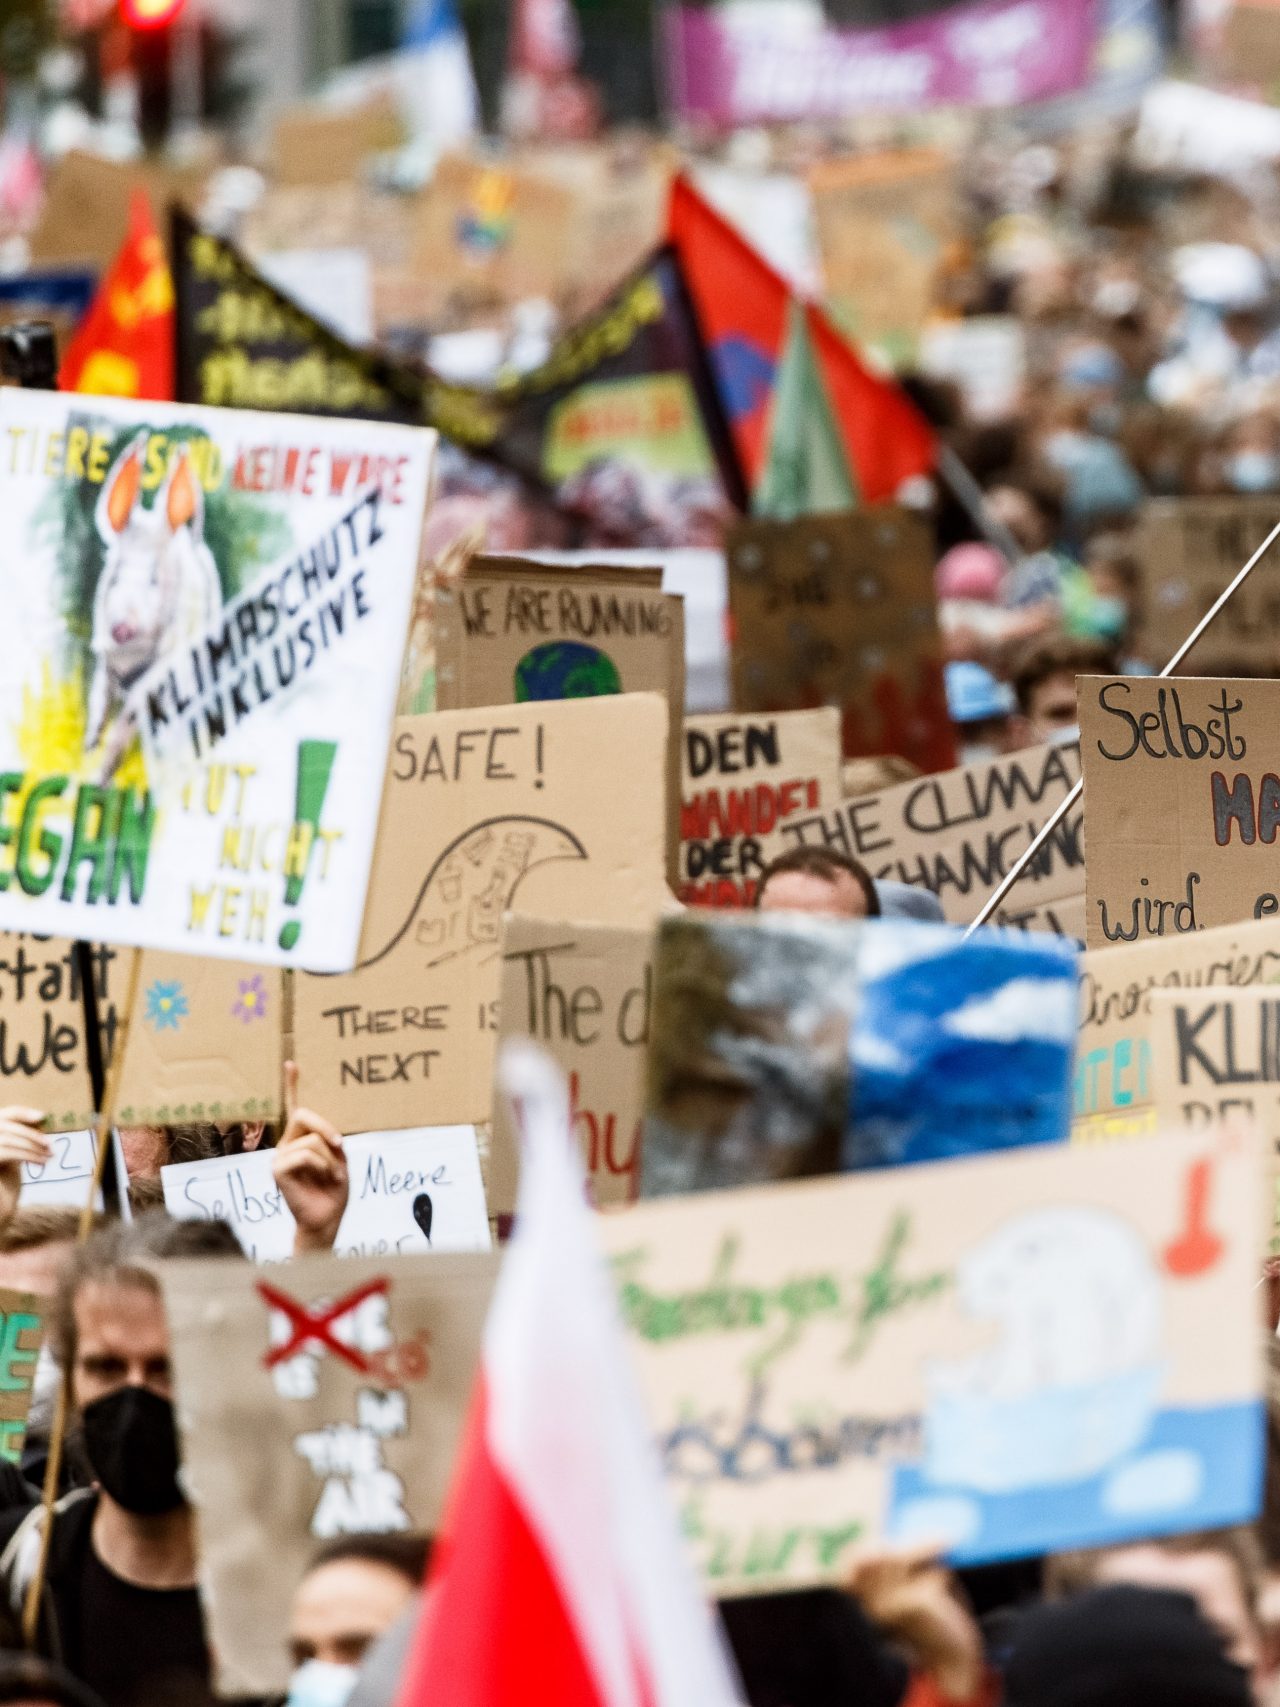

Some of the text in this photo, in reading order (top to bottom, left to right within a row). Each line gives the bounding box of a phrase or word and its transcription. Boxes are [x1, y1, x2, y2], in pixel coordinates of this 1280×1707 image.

[7, 427, 109, 484] TIERE
[140, 434, 222, 494] SND
[146, 489, 386, 736] KLIMASCHUTZ
[188, 570, 372, 758] INKLUSIVE
[686, 721, 780, 778] DEN
[1097, 682, 1246, 760] Selbst
[781, 798, 893, 856] THE
[686, 837, 766, 879] DER
[322, 1004, 450, 1038] THERE
[504, 943, 603, 1046] The
[340, 1050, 440, 1086] NEXT
[360, 1154, 453, 1199] Meere
